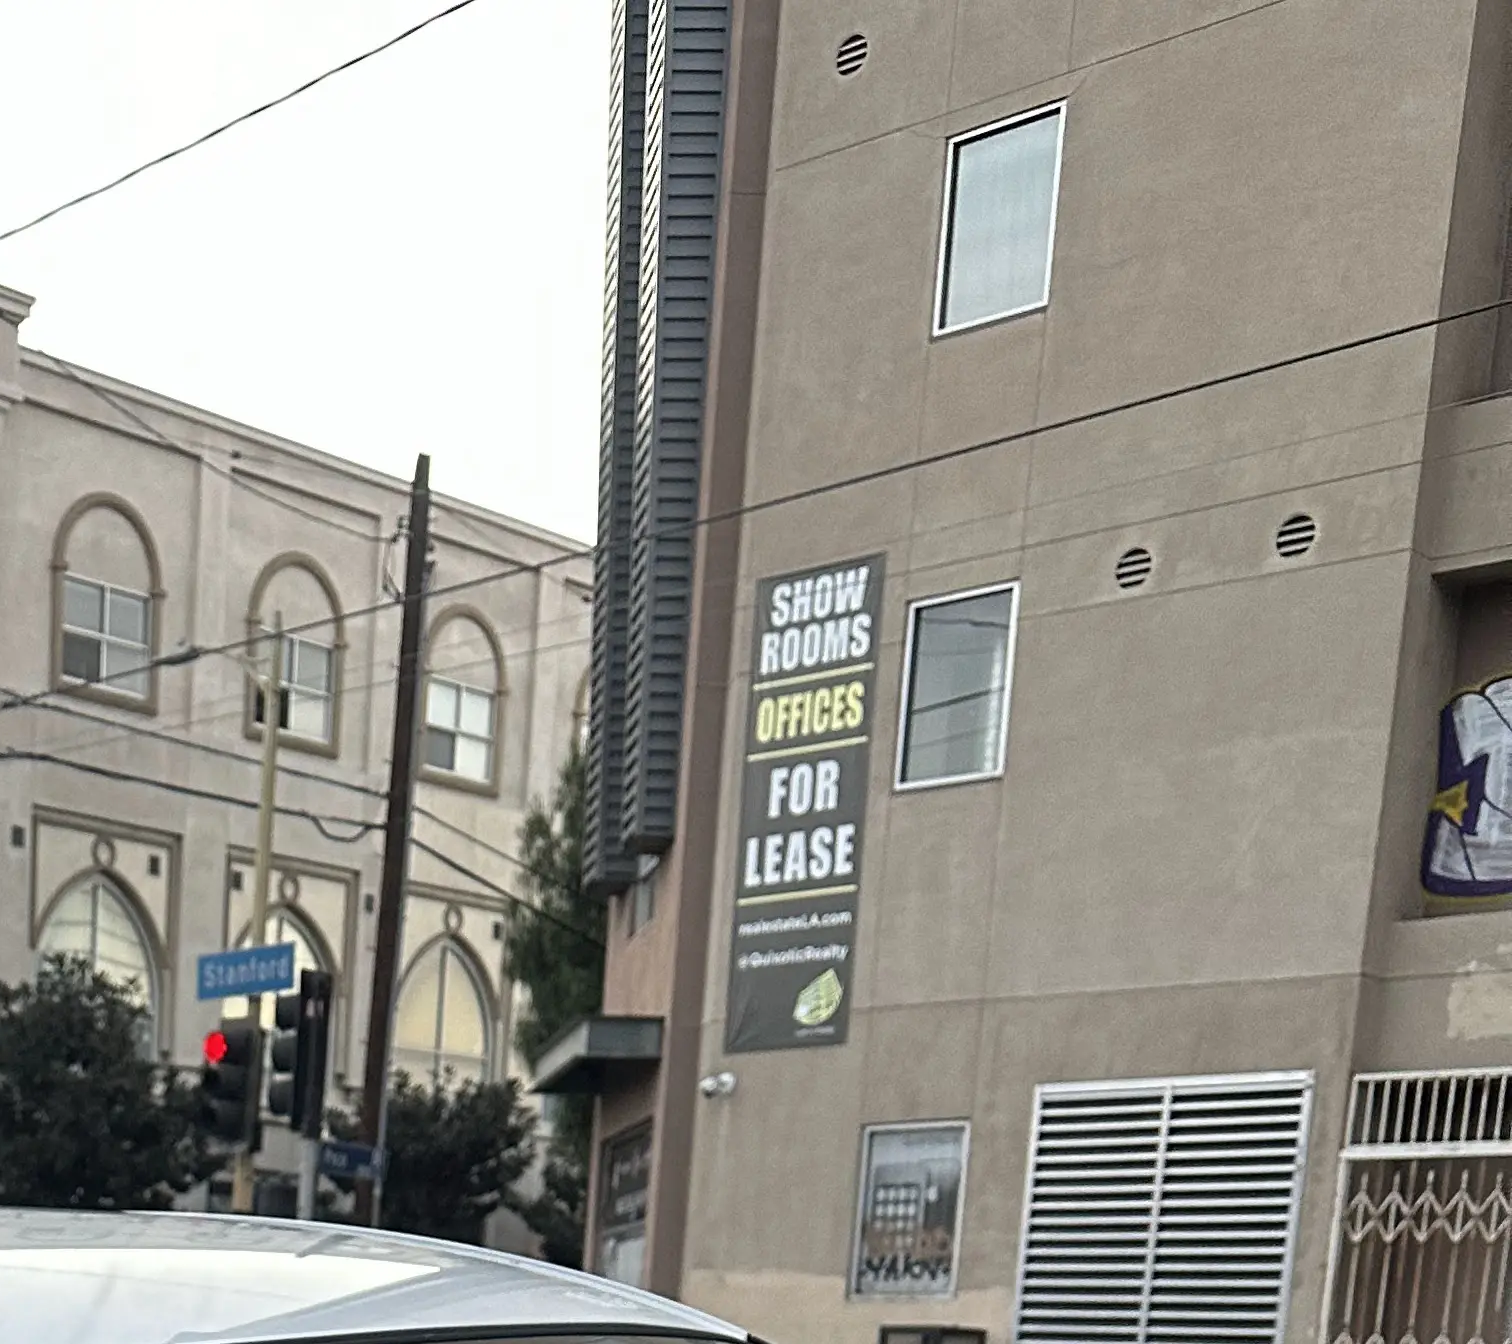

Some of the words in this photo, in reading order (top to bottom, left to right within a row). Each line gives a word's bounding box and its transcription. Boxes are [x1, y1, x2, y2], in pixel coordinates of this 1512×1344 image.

[771, 566, 870, 627] SHOW
[760, 614, 871, 675] ROOMS
[756, 681, 864, 742] OFFICES
[768, 759, 840, 819] FOR
[744, 823, 856, 888] LEASE
[203, 954, 289, 988] Stanford
